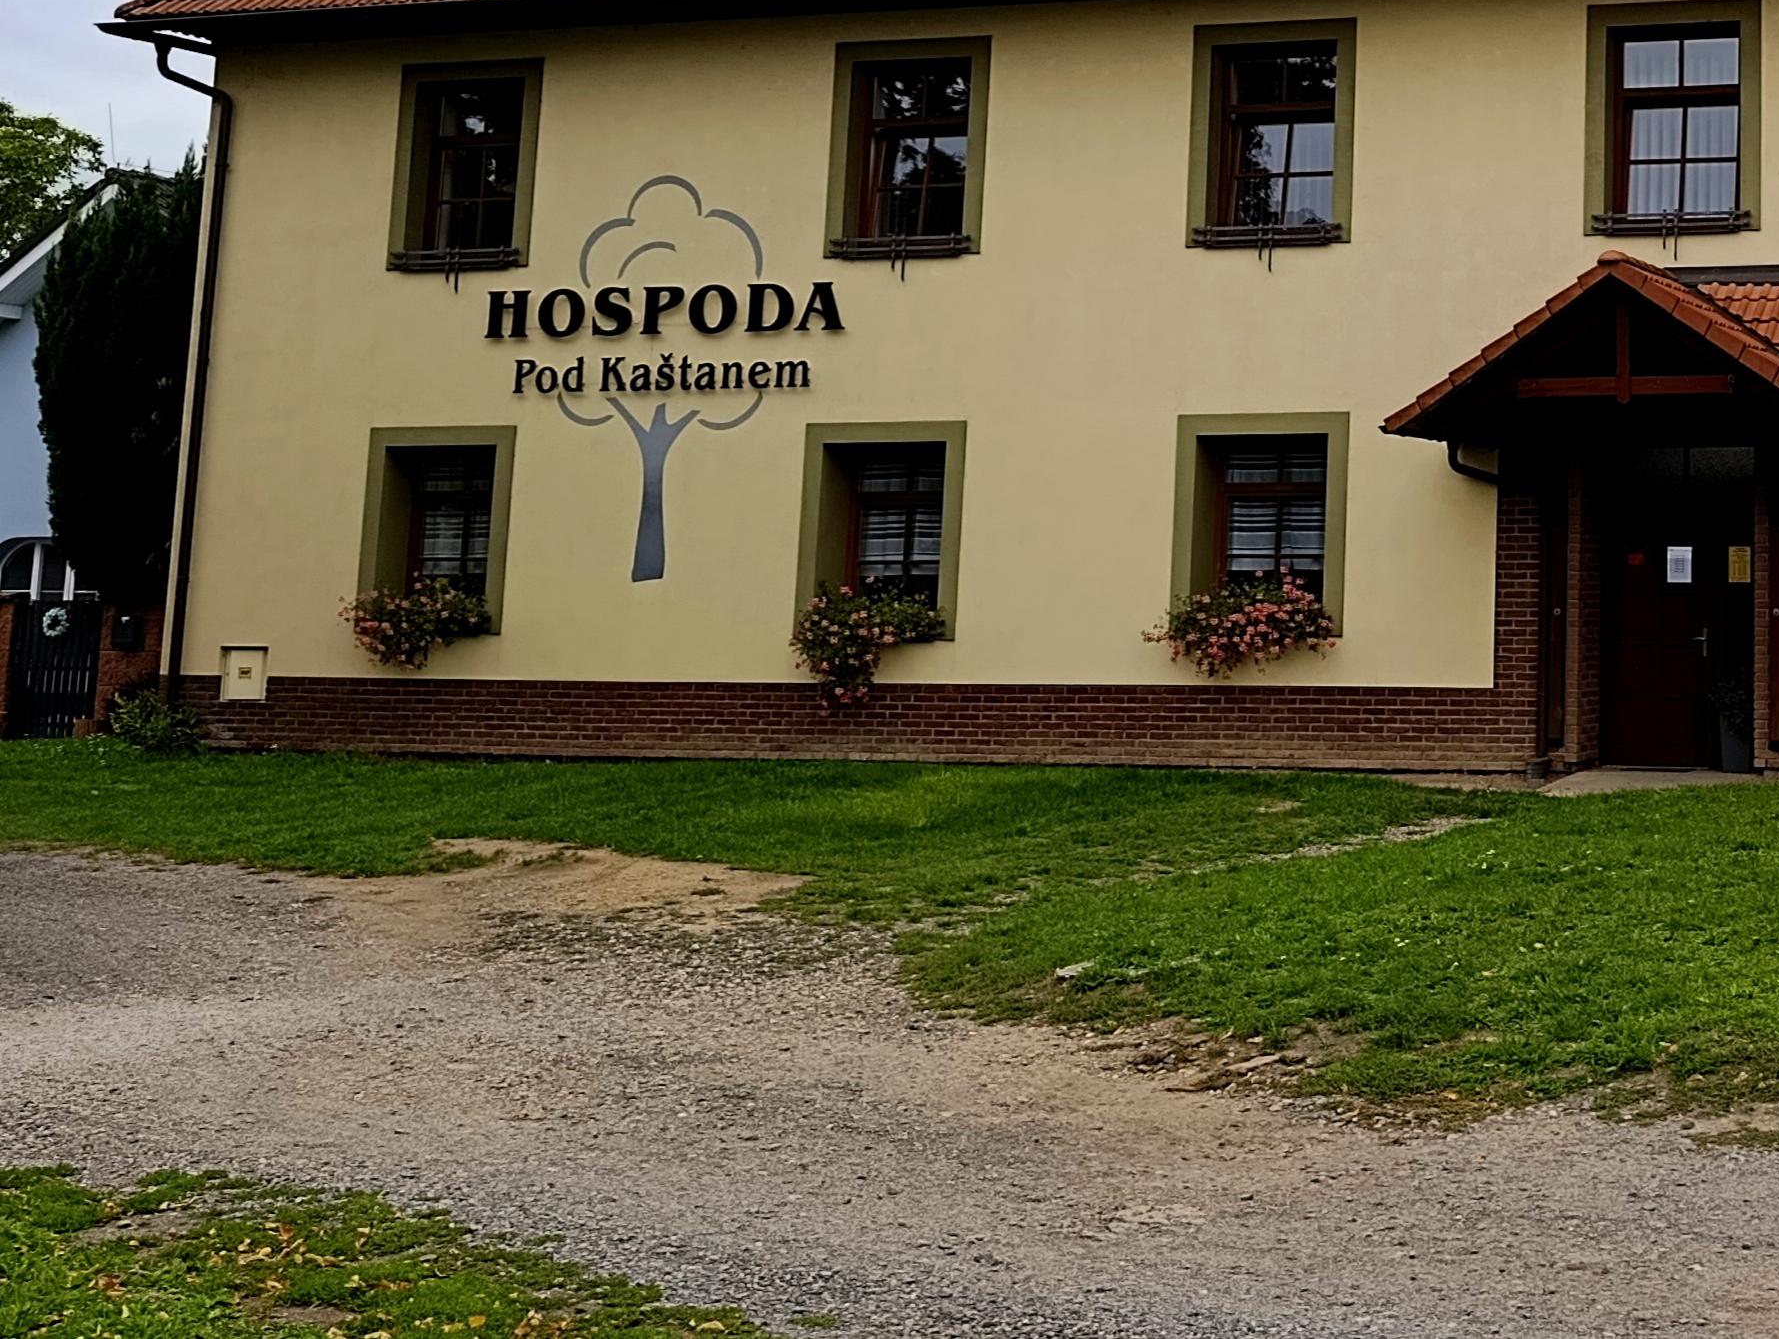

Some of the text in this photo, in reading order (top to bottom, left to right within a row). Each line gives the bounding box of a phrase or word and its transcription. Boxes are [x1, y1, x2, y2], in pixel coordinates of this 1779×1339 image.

[485, 281, 845, 339] HOSPODA
[513, 353, 810, 394] Pod Kaštanem
